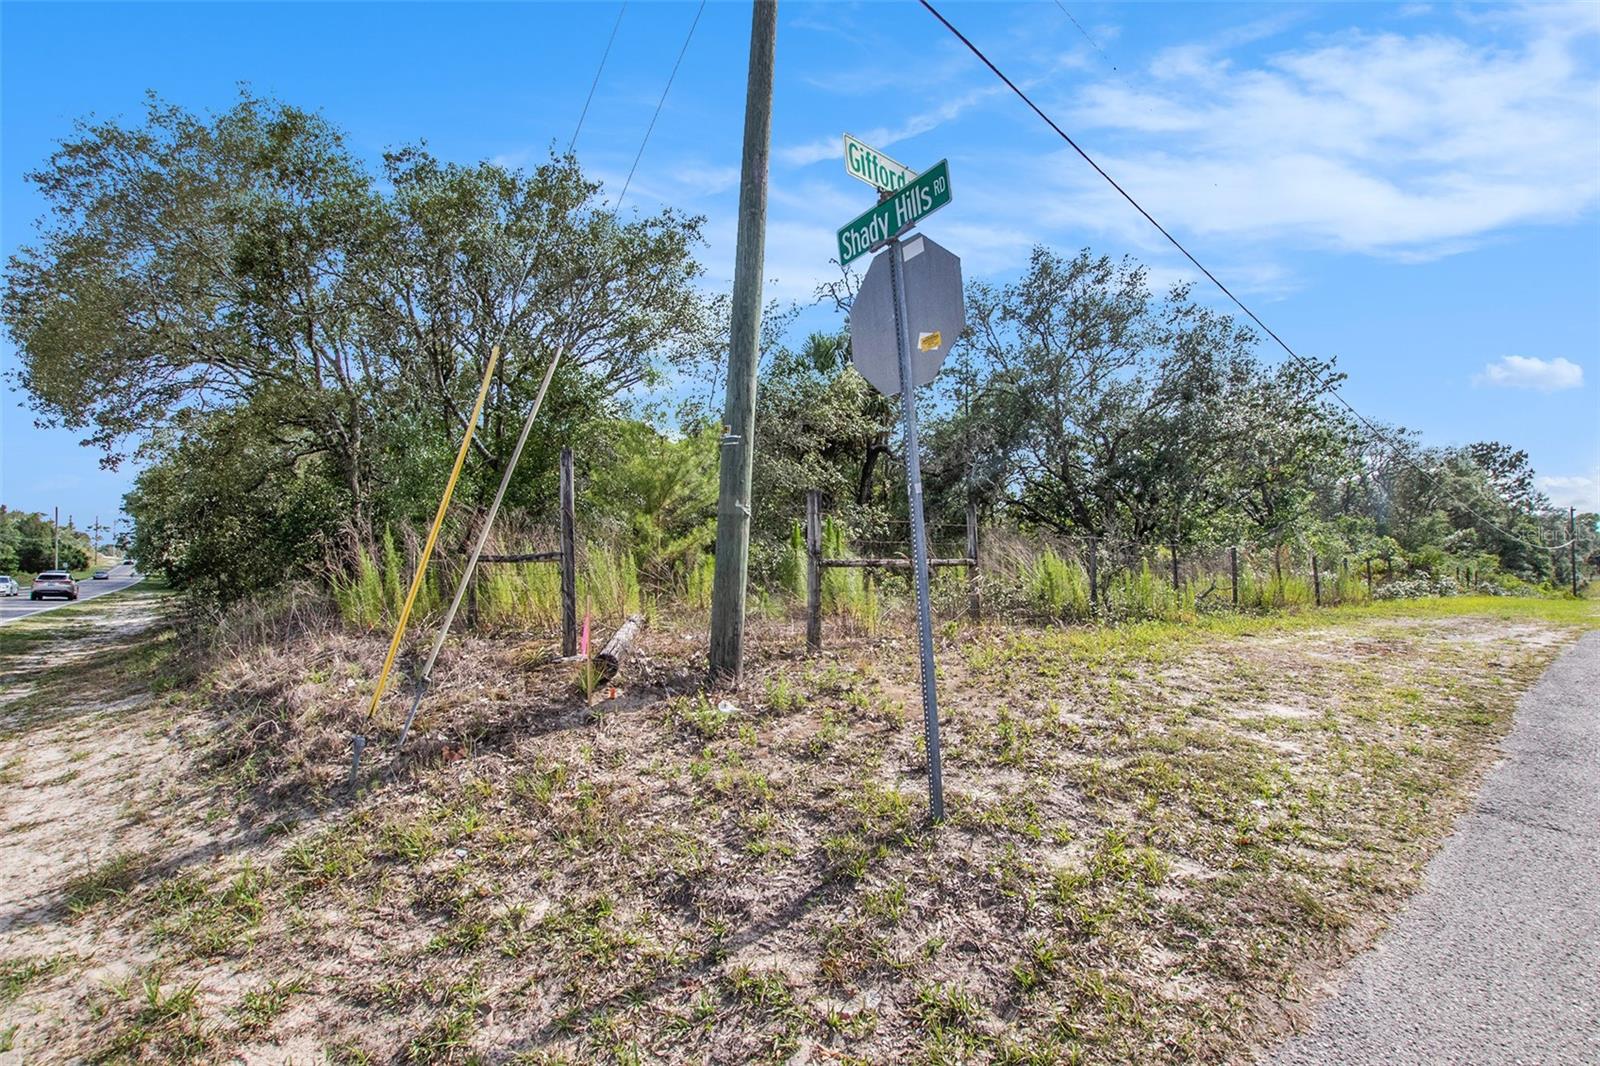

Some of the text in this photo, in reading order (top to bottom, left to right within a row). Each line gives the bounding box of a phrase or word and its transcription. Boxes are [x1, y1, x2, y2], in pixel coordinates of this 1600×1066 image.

[848, 142, 906, 190] Gifford
[842, 176, 946, 260] Shady Hills RD
